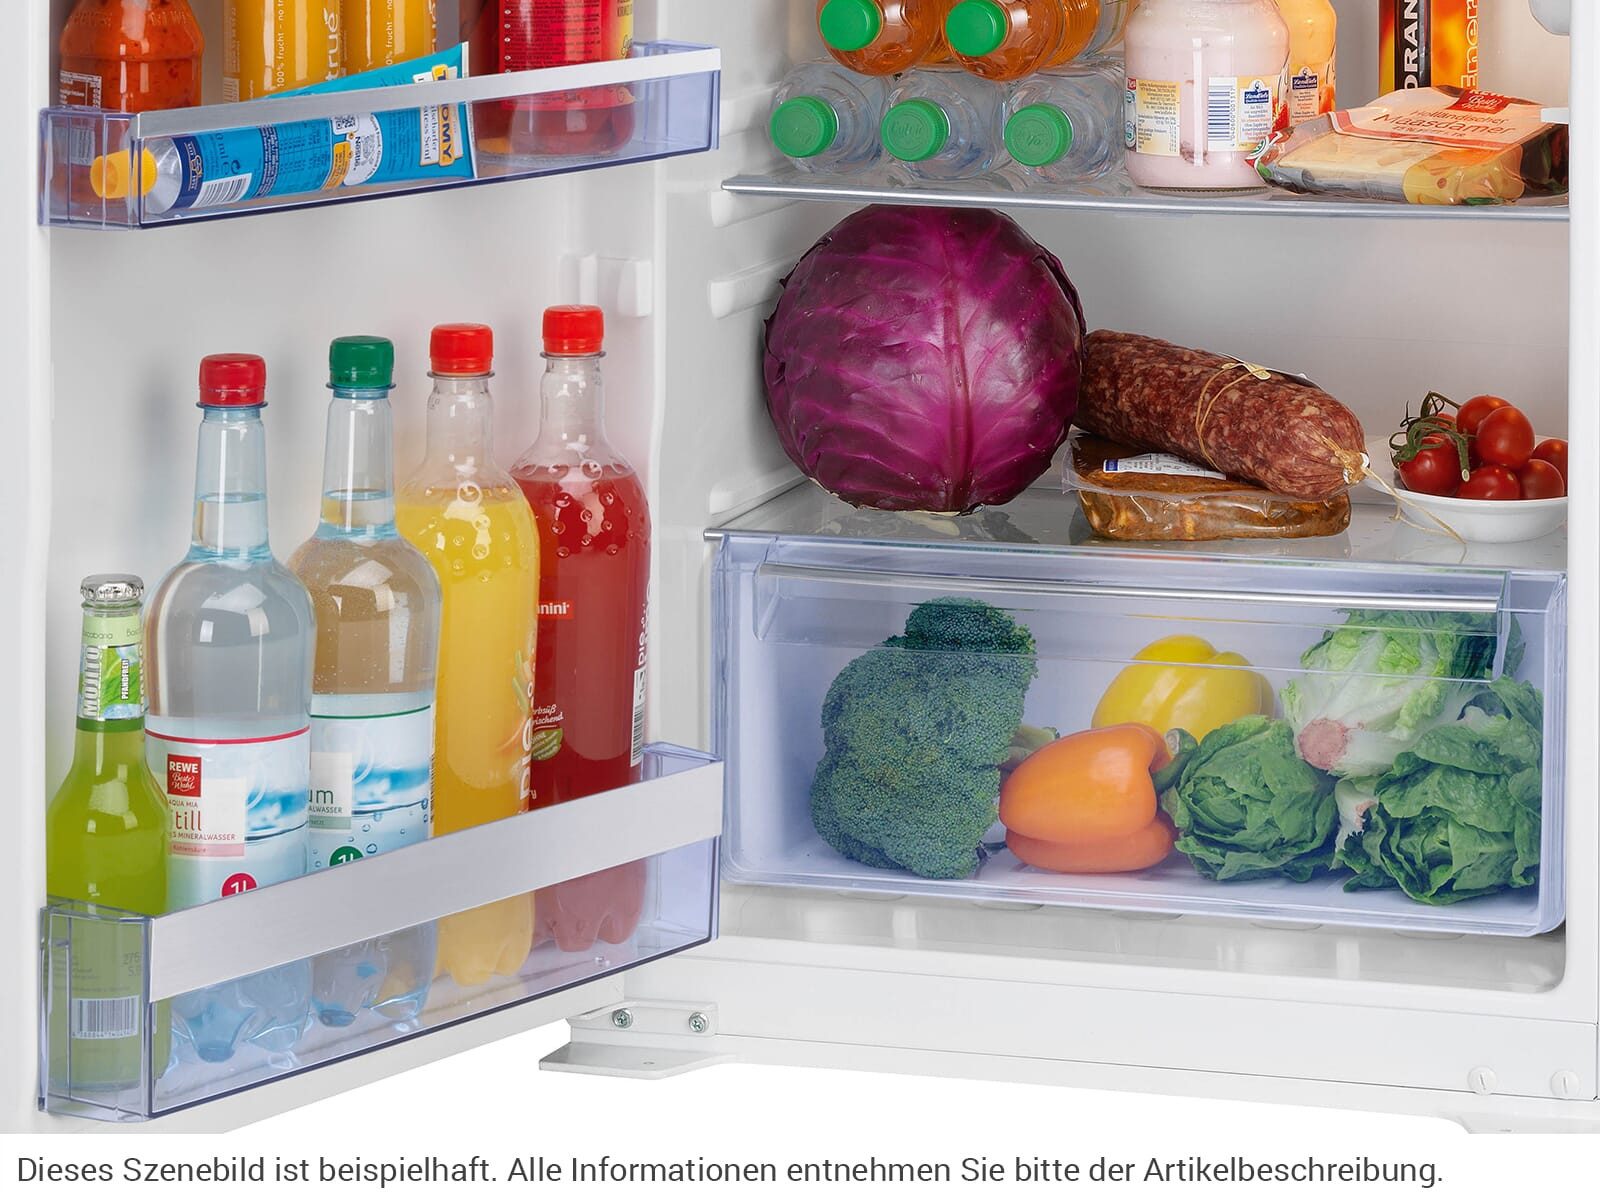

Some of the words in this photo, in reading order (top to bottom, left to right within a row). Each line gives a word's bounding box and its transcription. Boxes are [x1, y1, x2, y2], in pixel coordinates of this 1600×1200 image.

[385, 22, 393, 48] frucht
[276, 33, 285, 60] frucht
[1374, 113, 1516, 133] Maasdamer
[1410, 110, 1510, 125] Holländischer
[83, 645, 100, 718] MOJITO
[169, 760, 199, 774] REWE
[171, 808, 202, 831] till
[308, 805, 343, 814] ALWASSER
[178, 832, 236, 841] MINERALWASSER
